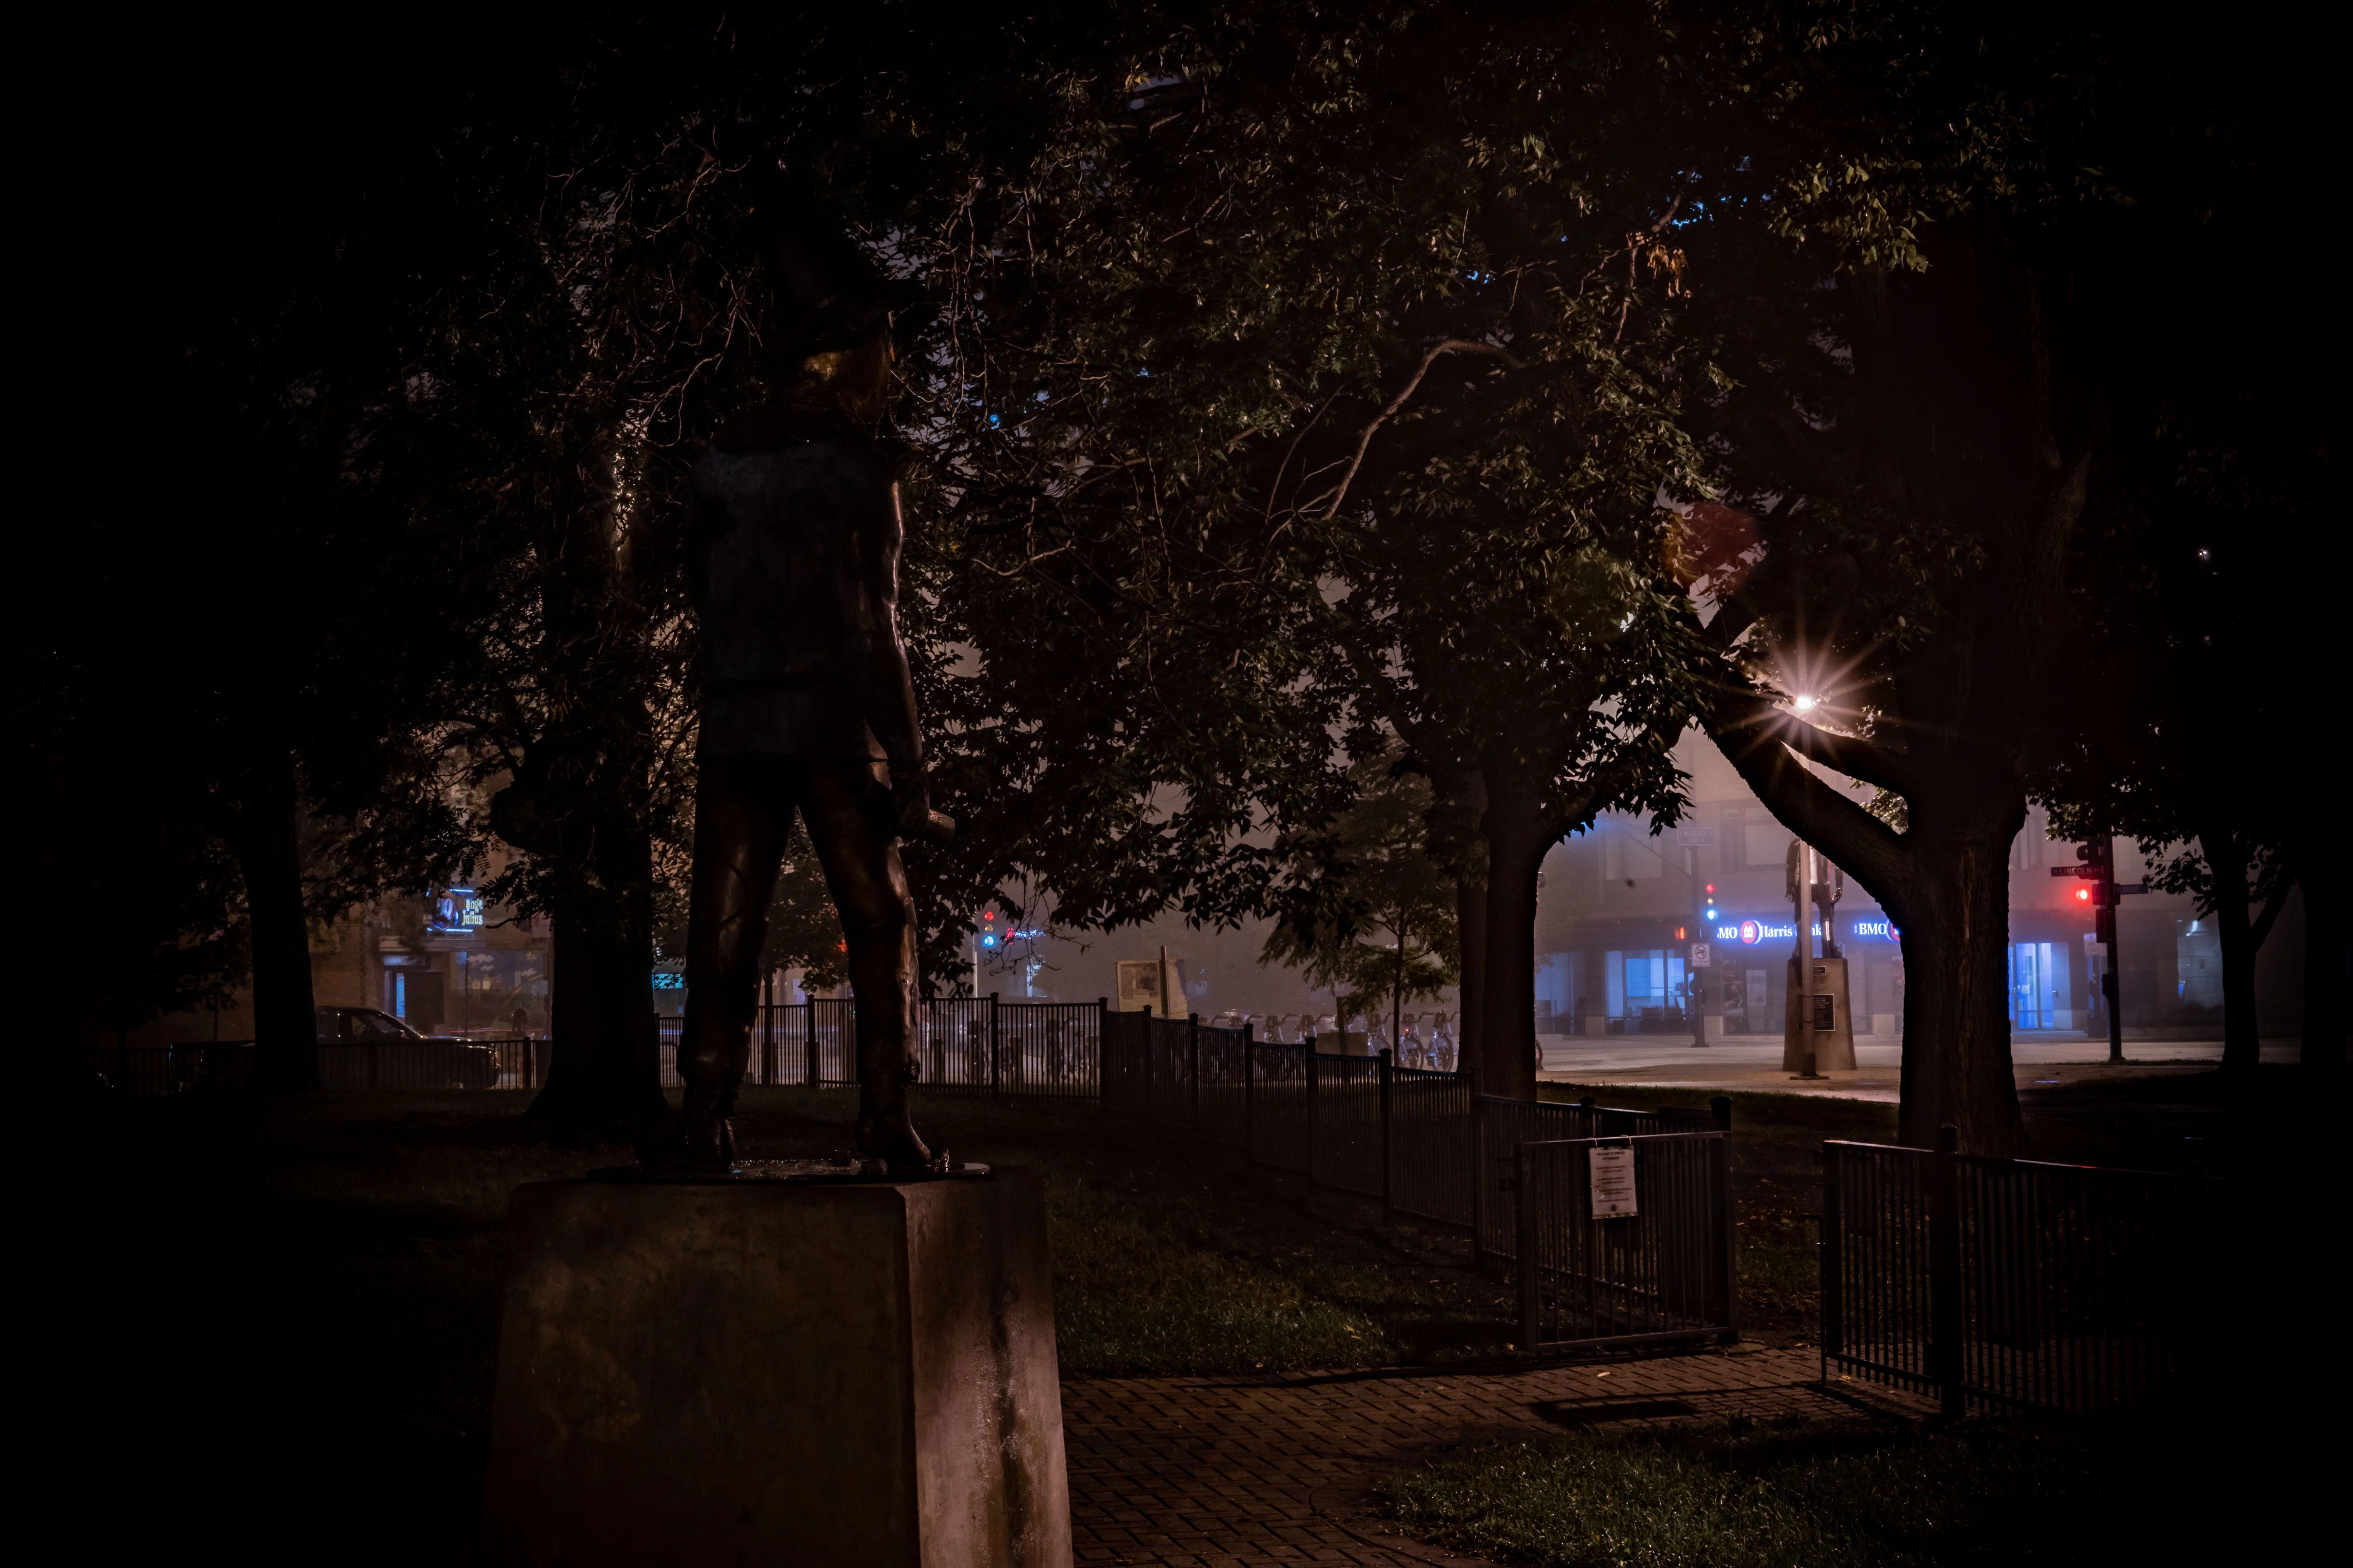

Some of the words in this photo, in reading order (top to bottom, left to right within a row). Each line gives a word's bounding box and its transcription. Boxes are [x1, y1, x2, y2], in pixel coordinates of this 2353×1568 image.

[2059, 867, 2091, 875] LINCOLN
[461, 910, 483, 926] Julius
[1760, 925, 1793, 938] Harris
[1858, 922, 1887, 935] BMO
